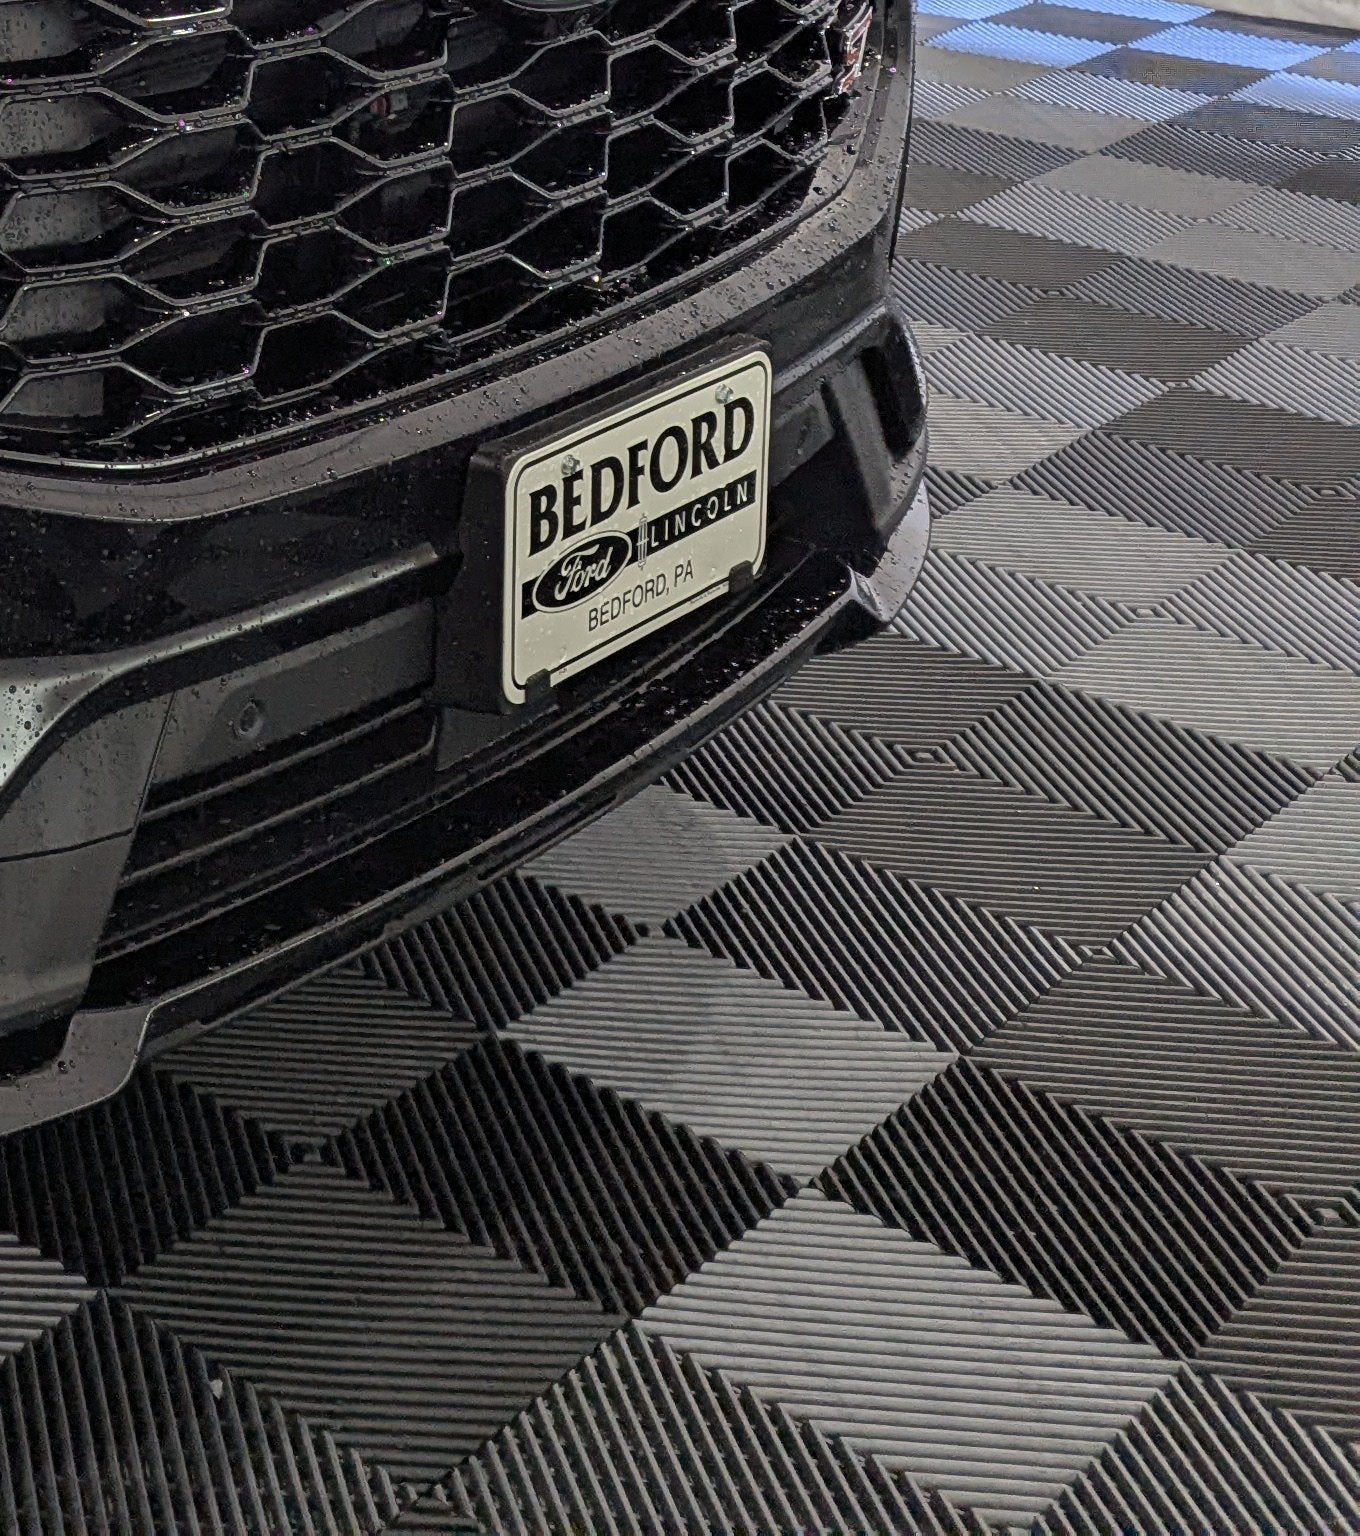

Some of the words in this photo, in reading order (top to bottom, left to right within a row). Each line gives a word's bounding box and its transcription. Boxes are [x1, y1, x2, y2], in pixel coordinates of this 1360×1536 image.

[528, 397, 755, 558] BEDFORD
[554, 544, 614, 601] Ford
[651, 481, 749, 548] LINCOLN
[588, 573, 670, 632] BEDFORD,
[674, 560, 694, 588] PA
